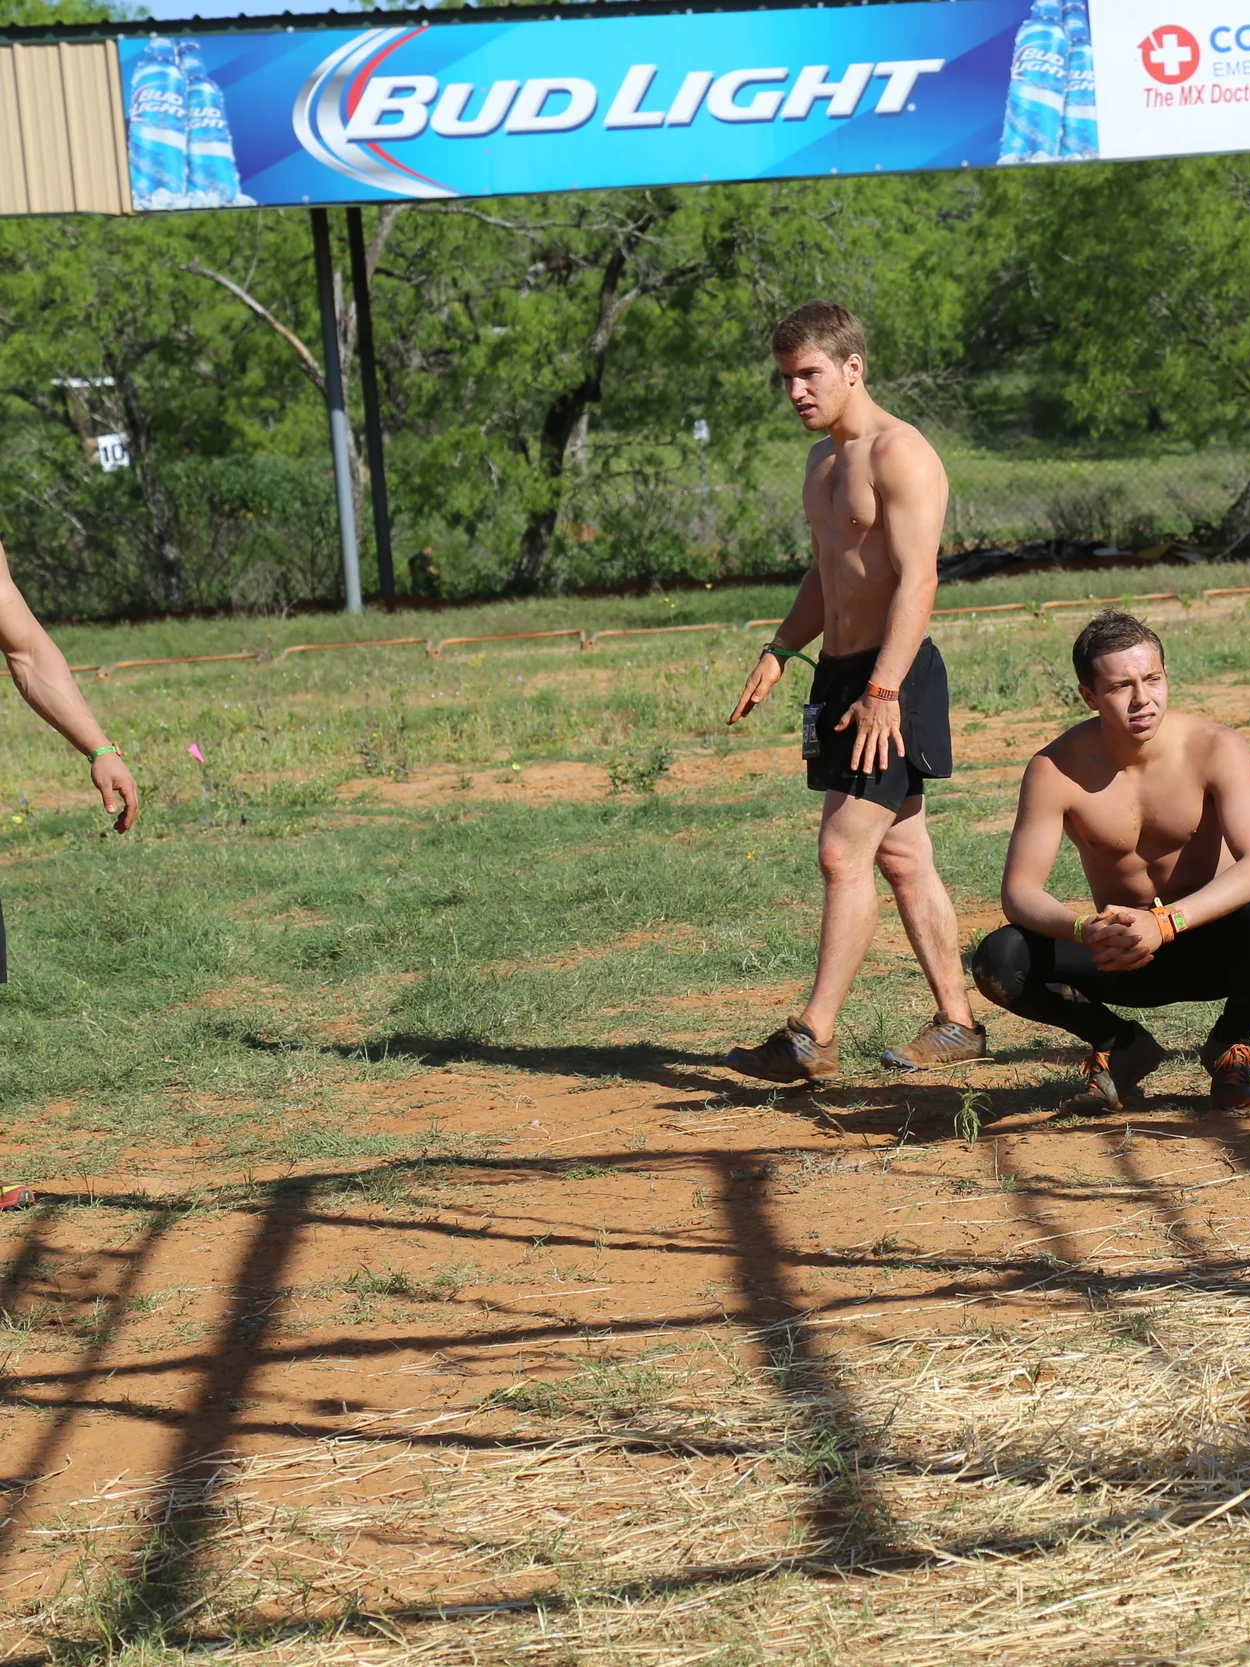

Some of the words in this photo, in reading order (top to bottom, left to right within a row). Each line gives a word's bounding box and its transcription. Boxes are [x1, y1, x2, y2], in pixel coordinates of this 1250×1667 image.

[341, 75, 599, 144] BUD
[602, 58, 946, 132] LIGHT
[1143, 86, 1174, 108] The
[1179, 83, 1206, 106] MX
[103, 443, 126, 462] 10
